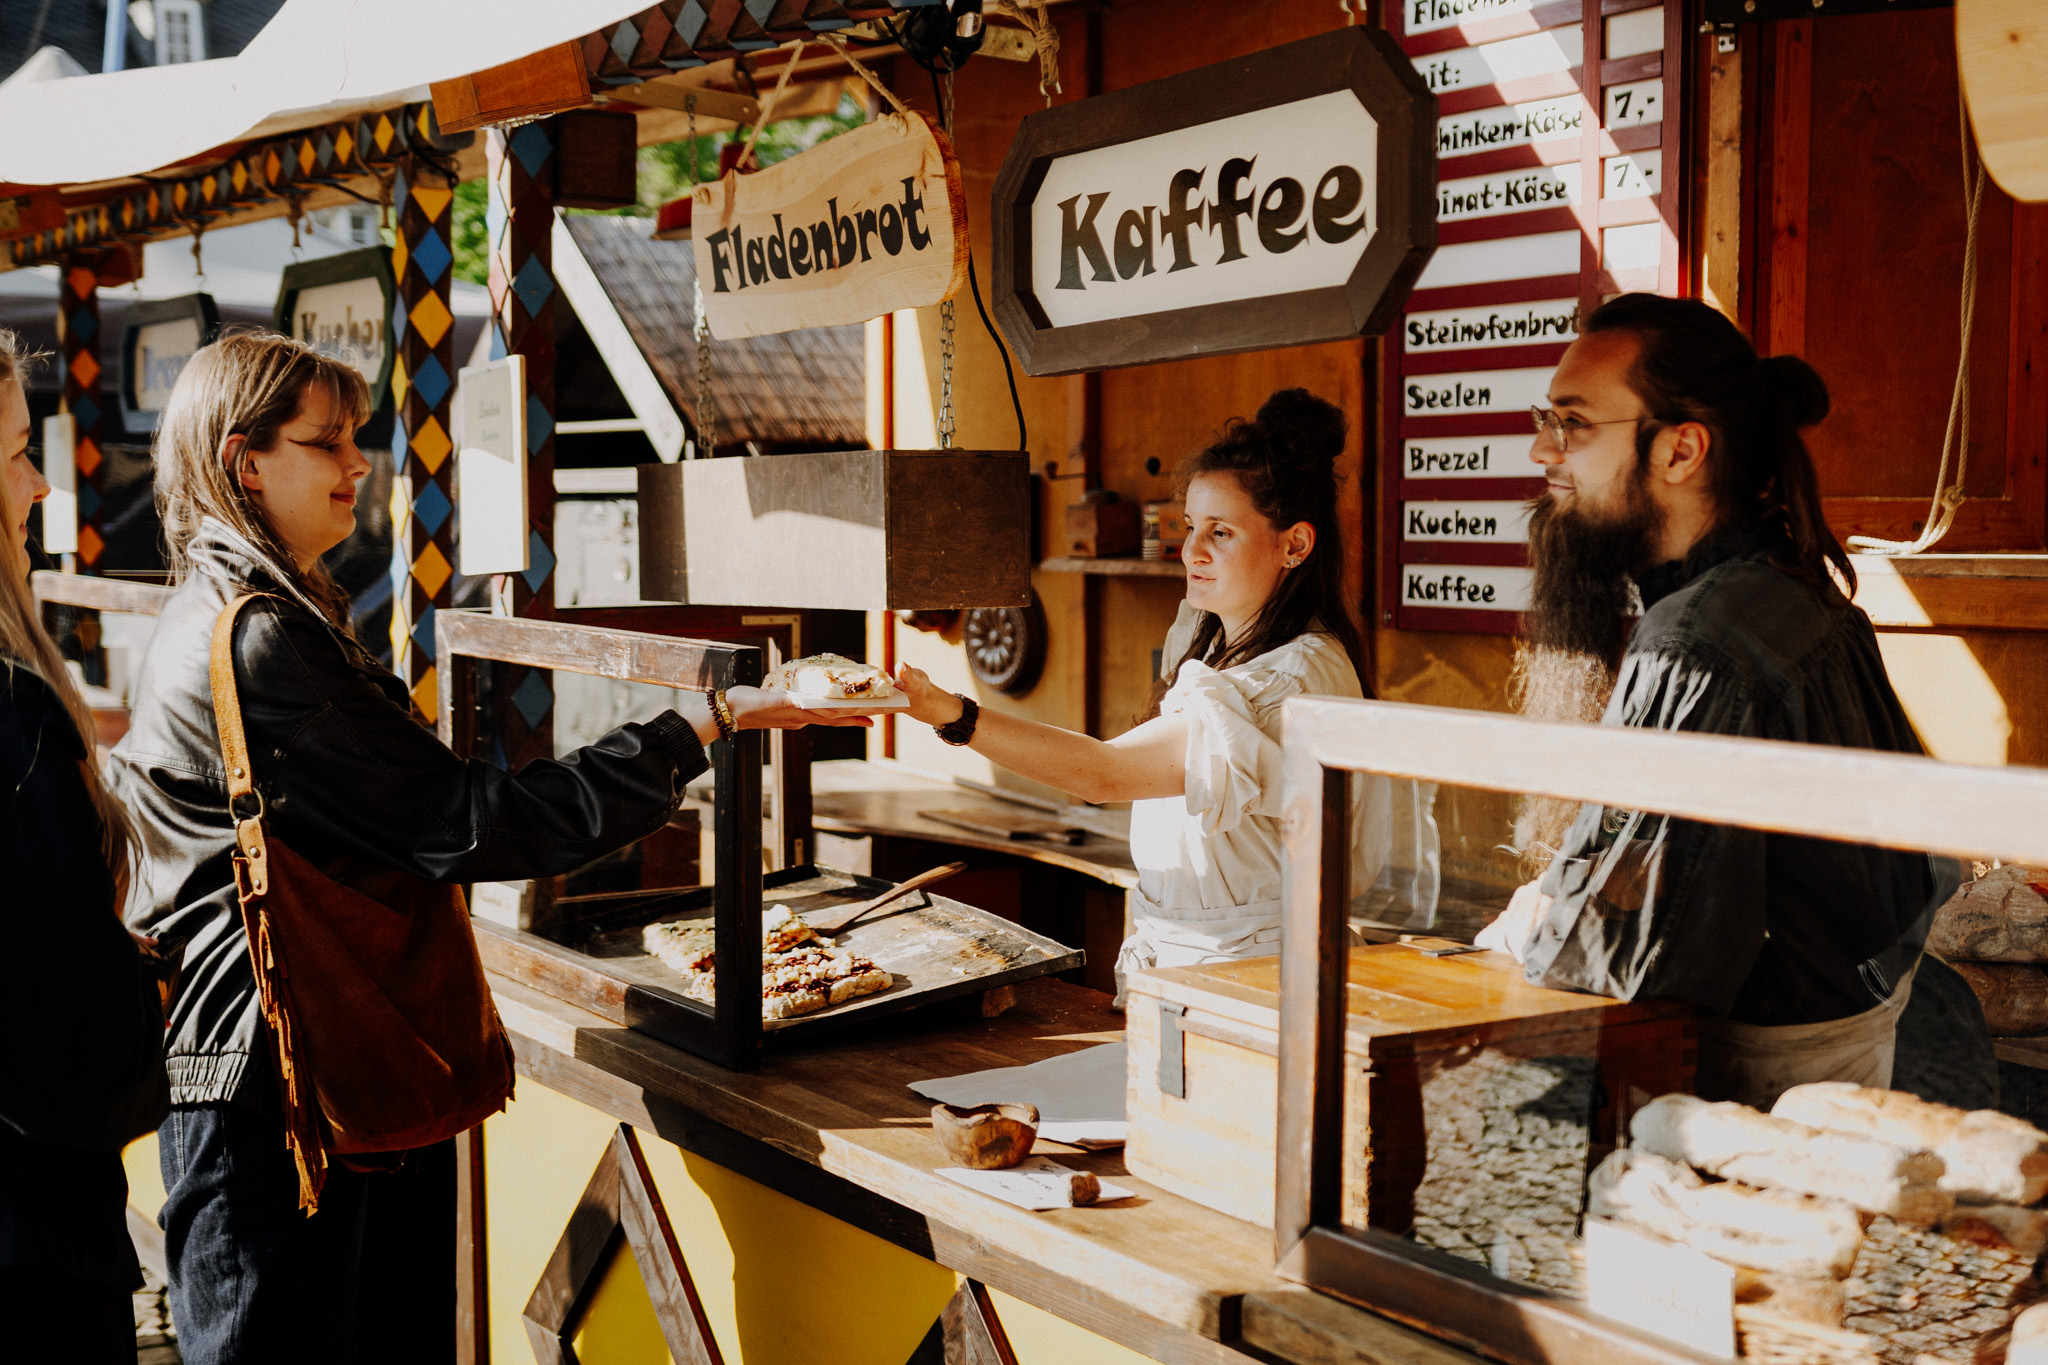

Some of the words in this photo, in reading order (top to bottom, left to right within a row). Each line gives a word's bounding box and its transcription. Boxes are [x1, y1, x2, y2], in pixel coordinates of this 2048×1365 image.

[1420, 61, 1460, 89] it:
[1614, 89, 1656, 124] 7,-
[1436, 106, 1581, 153] hinken-Käse
[1437, 175, 1568, 216] inat-Käse
[705, 176, 933, 293] Fladenbrot
[1045, 153, 1368, 291] Kaffee
[1407, 311, 1580, 347] Steinofenbrot
[1407, 382, 1492, 410] Seelen
[1408, 446, 1490, 473] Brezel
[1408, 510, 1498, 536] Kuchen
[1406, 574, 1497, 603] Kaffee
